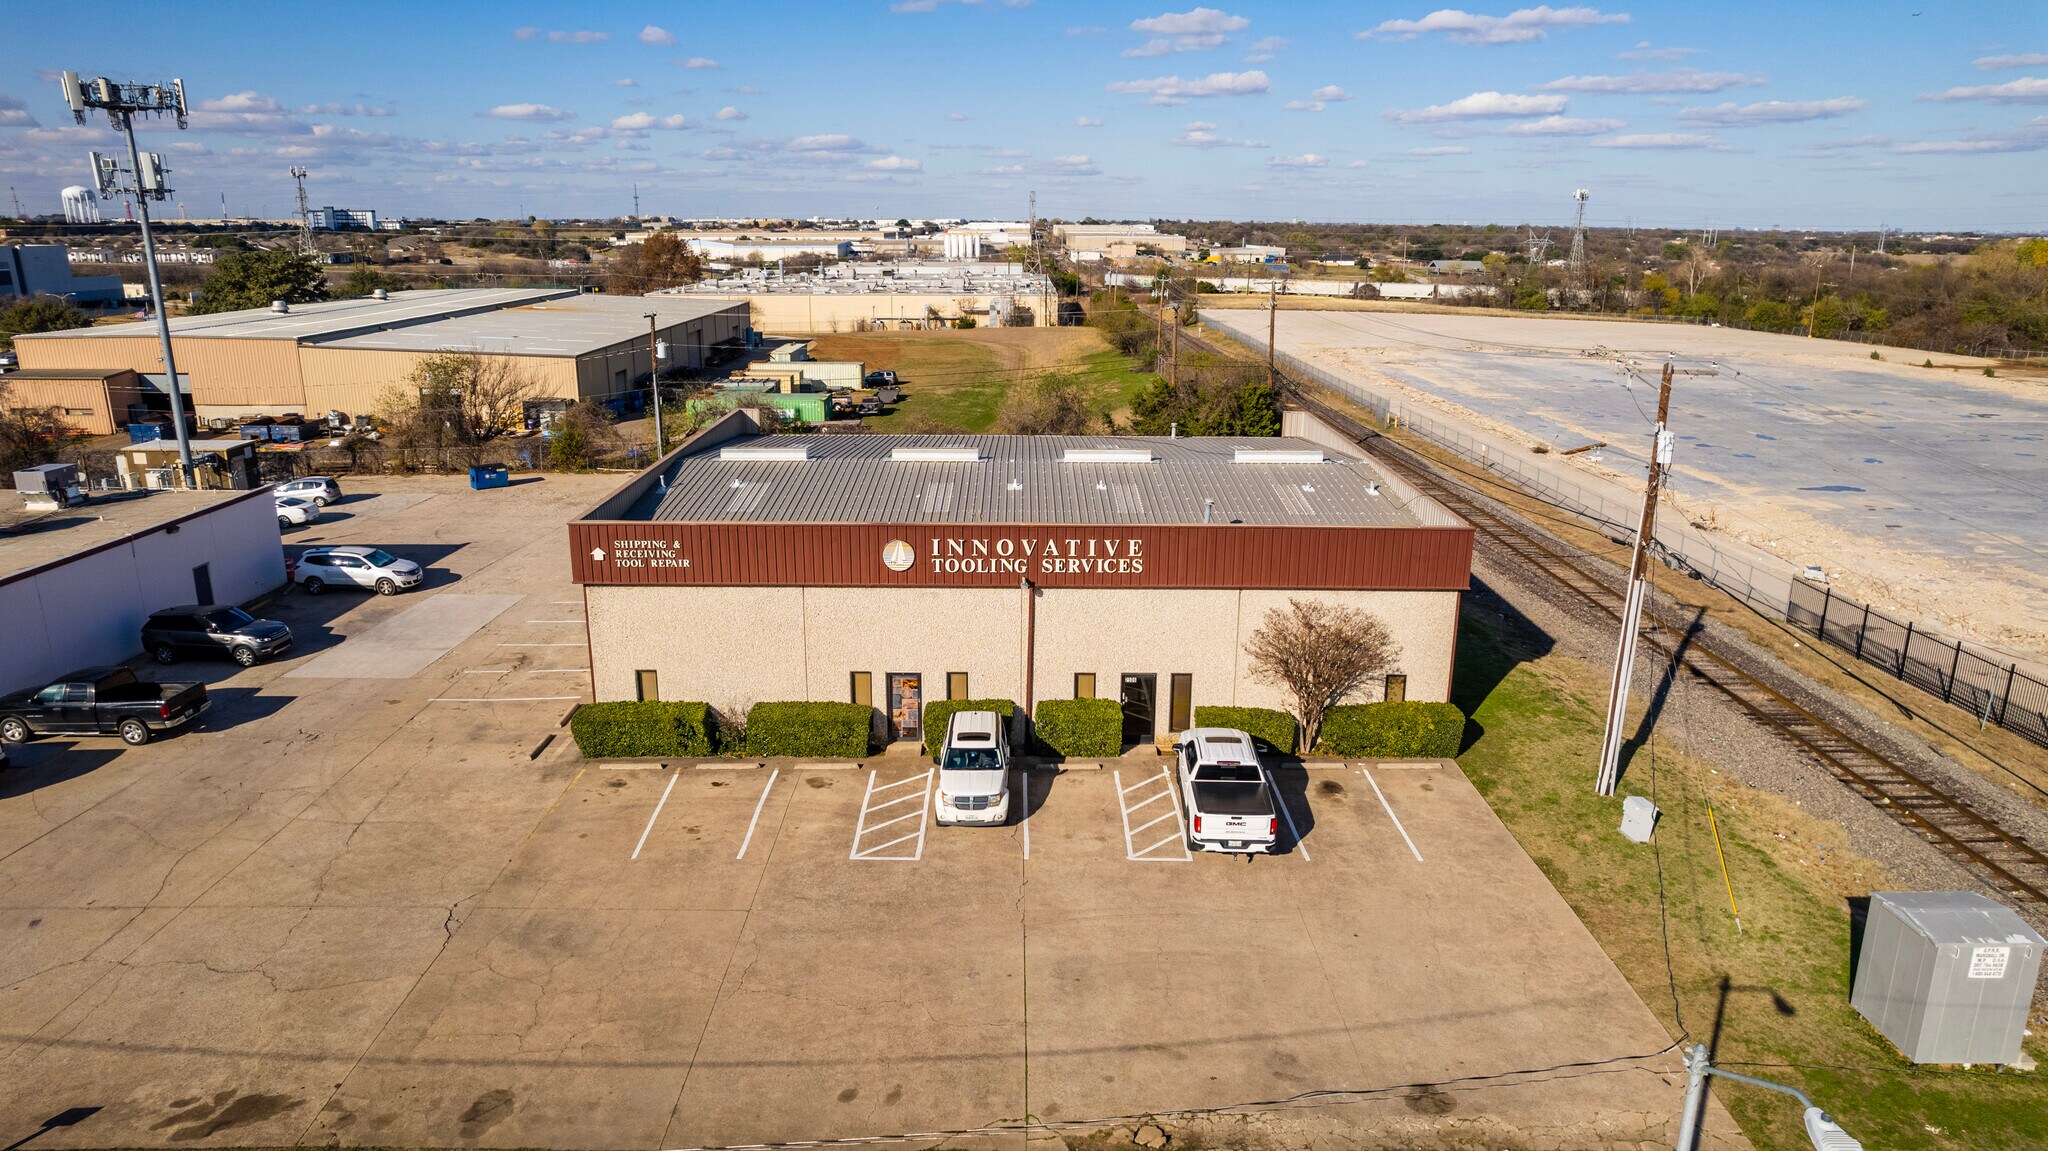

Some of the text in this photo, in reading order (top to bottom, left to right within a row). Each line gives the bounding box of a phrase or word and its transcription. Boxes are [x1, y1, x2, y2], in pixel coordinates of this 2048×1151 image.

[614, 540, 681, 549] SHIPPING &
[931, 538, 1143, 556] INNOVATIVE
[615, 549, 676, 558] RECEIVING
[615, 558, 690, 568] TOOL REPAIR
[931, 558, 1143, 574] TOOLING SERVICES
